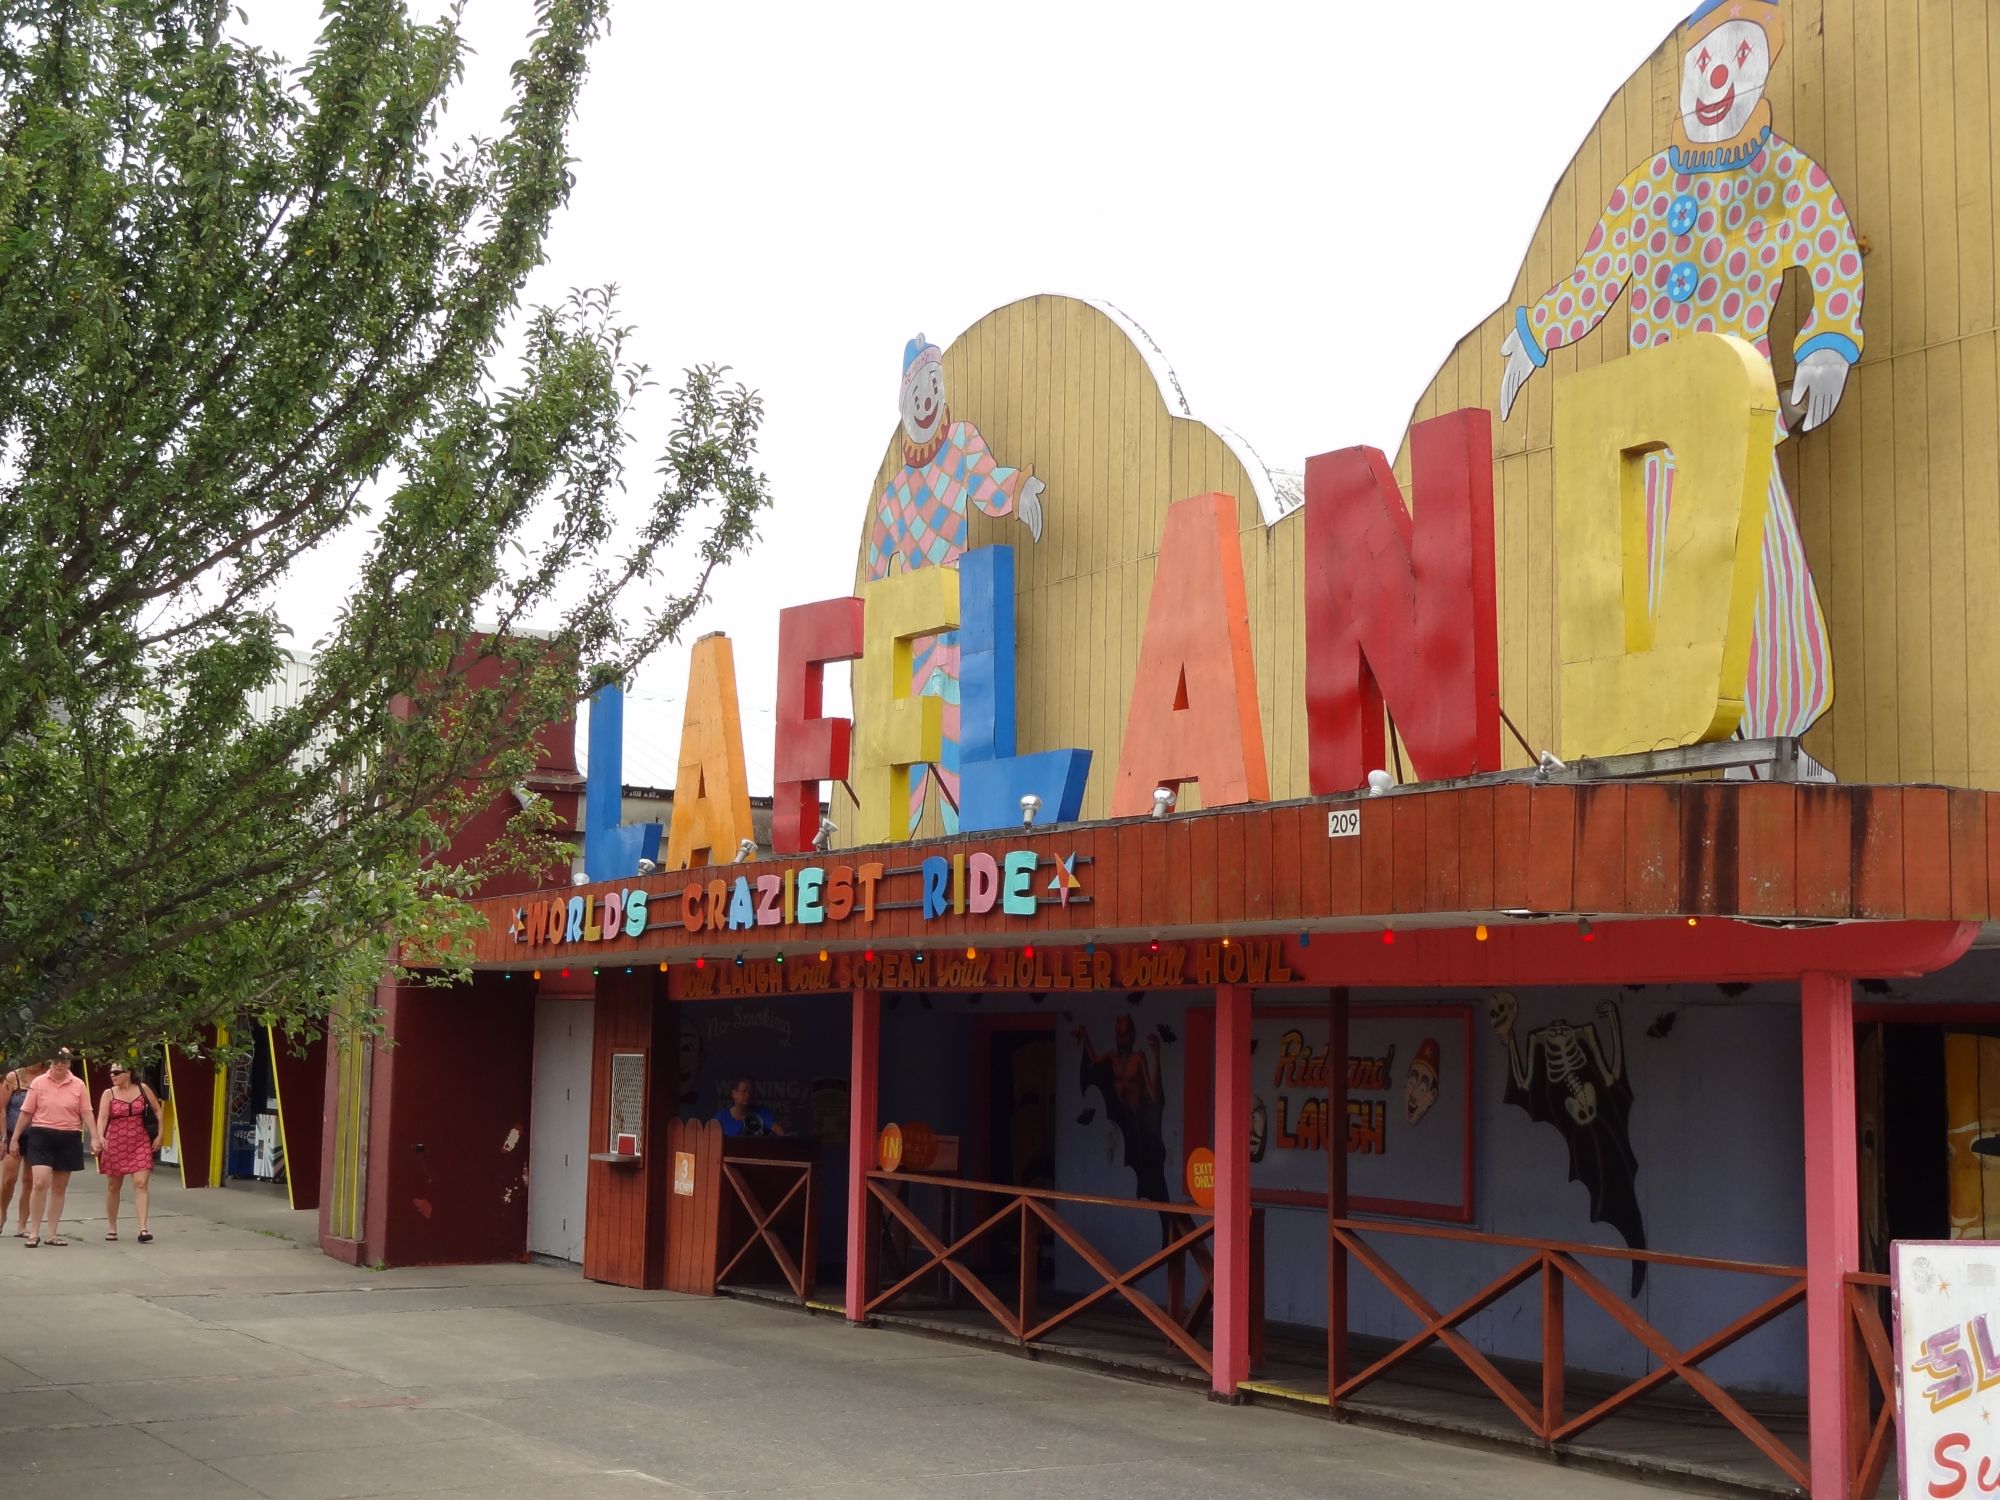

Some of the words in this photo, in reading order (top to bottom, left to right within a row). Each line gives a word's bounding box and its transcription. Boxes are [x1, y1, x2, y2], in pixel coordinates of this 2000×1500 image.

[1331, 813, 1358, 834] 209
[526, 888, 649, 946] WORLD'S
[681, 861, 885, 932] CRAZIEST
[922, 850, 1039, 920] RIDE
[719, 961, 783, 994] LAUGH
[838, 952, 930, 989] SCREAM
[996, 950, 1113, 989] HOLLER
[1196, 940, 1292, 984] HOWL
[1274, 1029, 1330, 1088] Rid
[884, 1135, 900, 1160] IN
[681, 1158, 689, 1179] 3
[1193, 1162, 1213, 1176] EXIT
[1194, 1175, 1215, 1189] ONLY
